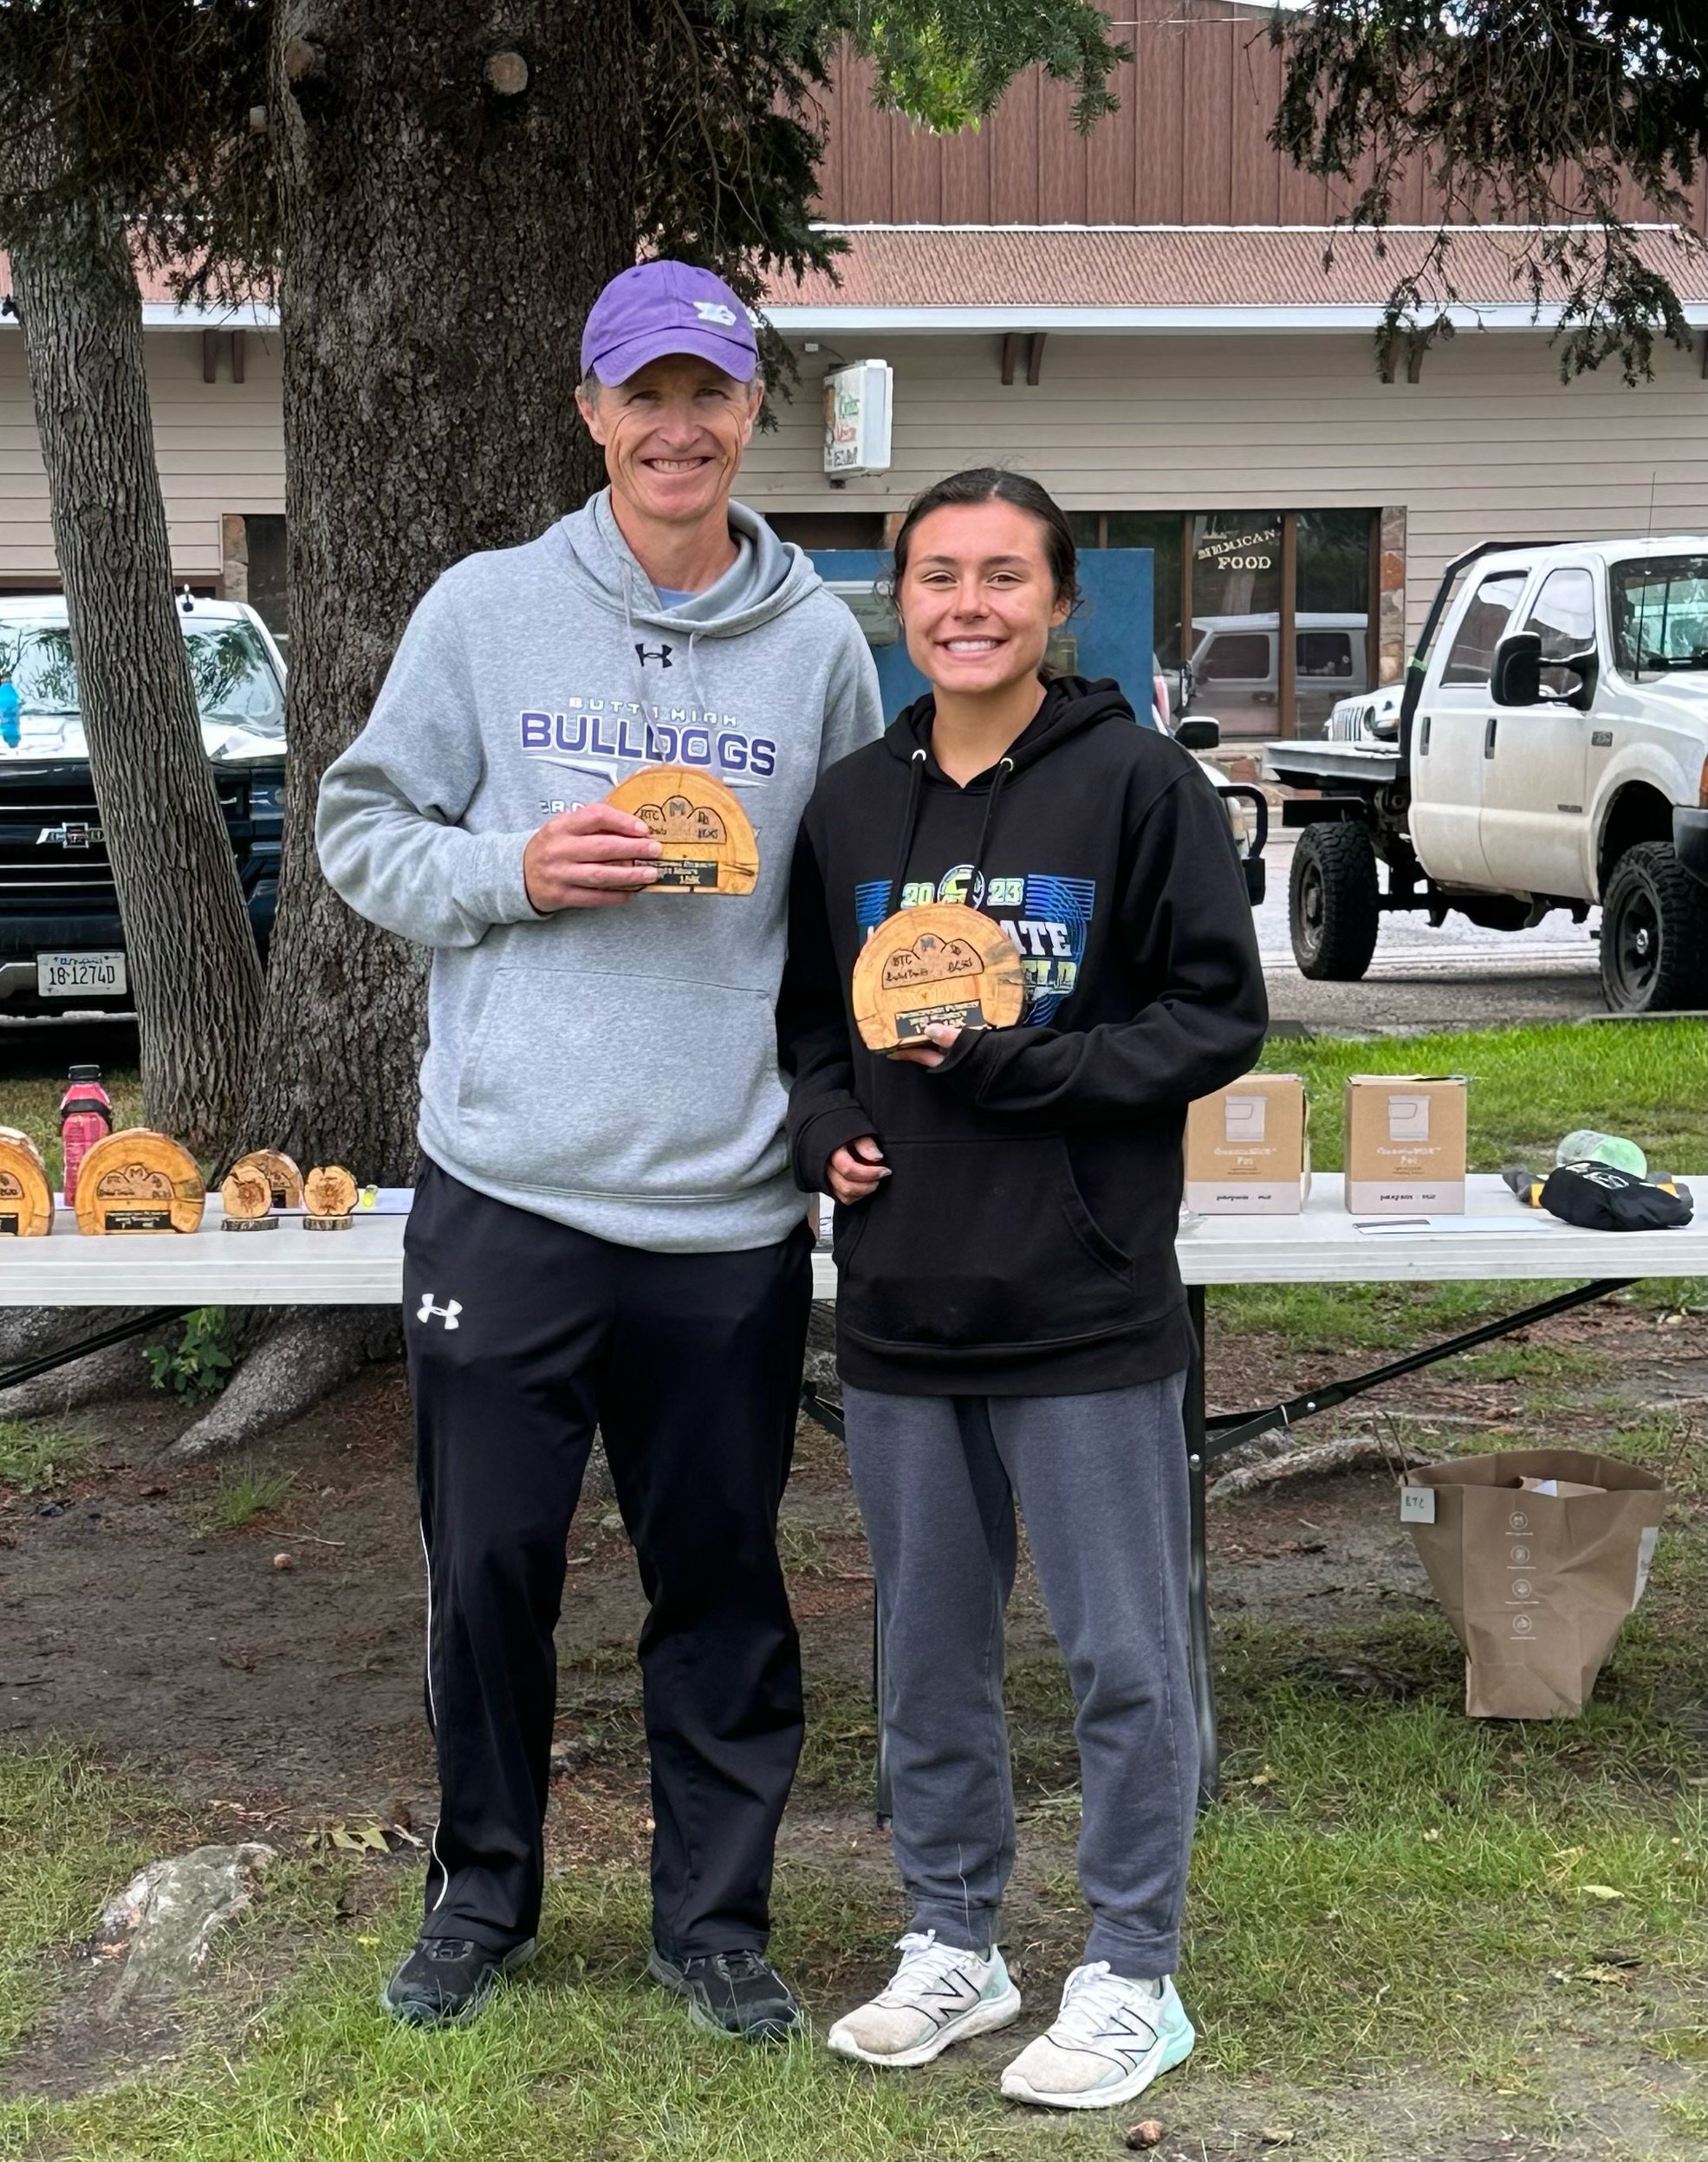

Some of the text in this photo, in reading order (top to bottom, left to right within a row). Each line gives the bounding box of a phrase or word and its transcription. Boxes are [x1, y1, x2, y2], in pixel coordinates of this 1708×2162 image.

[1218, 555, 1272, 570] FOOD
[520, 709, 778, 779] BULLDOGS
[900, 882, 936, 910] 20
[987, 877, 1025, 906] 23
[999, 919, 1073, 957] ATE
